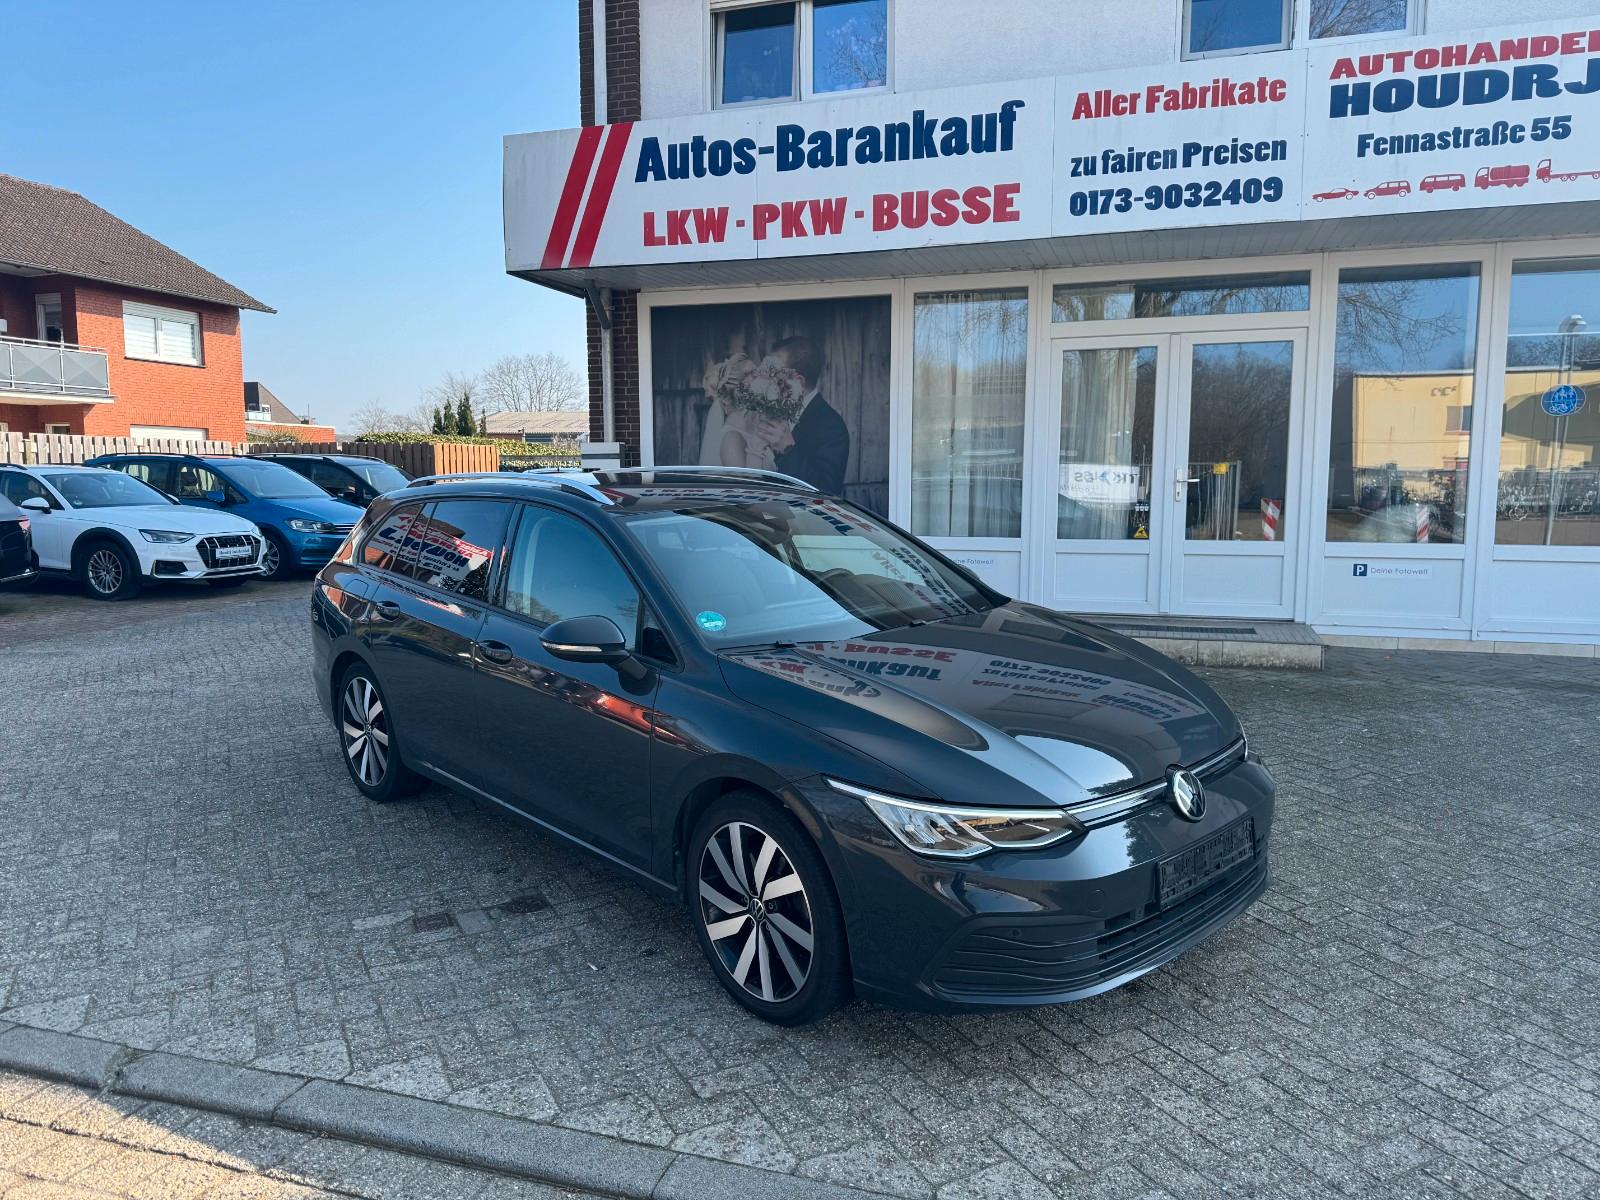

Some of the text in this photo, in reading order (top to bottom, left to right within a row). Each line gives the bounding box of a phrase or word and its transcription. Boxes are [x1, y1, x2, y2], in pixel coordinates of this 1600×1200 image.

[1072, 77, 1286, 120] Aller Fabrikate
[1329, 57, 1600, 119] HOUDRJ
[634, 99, 1026, 184] Autos-Barankauf
[1070, 138, 1288, 178] zu fairen Preisen
[1356, 115, 1572, 158] Fennastraße 55
[643, 182, 1020, 247] LKW PKW BUSSE
[1069, 176, 1284, 217] 0173-9032409
